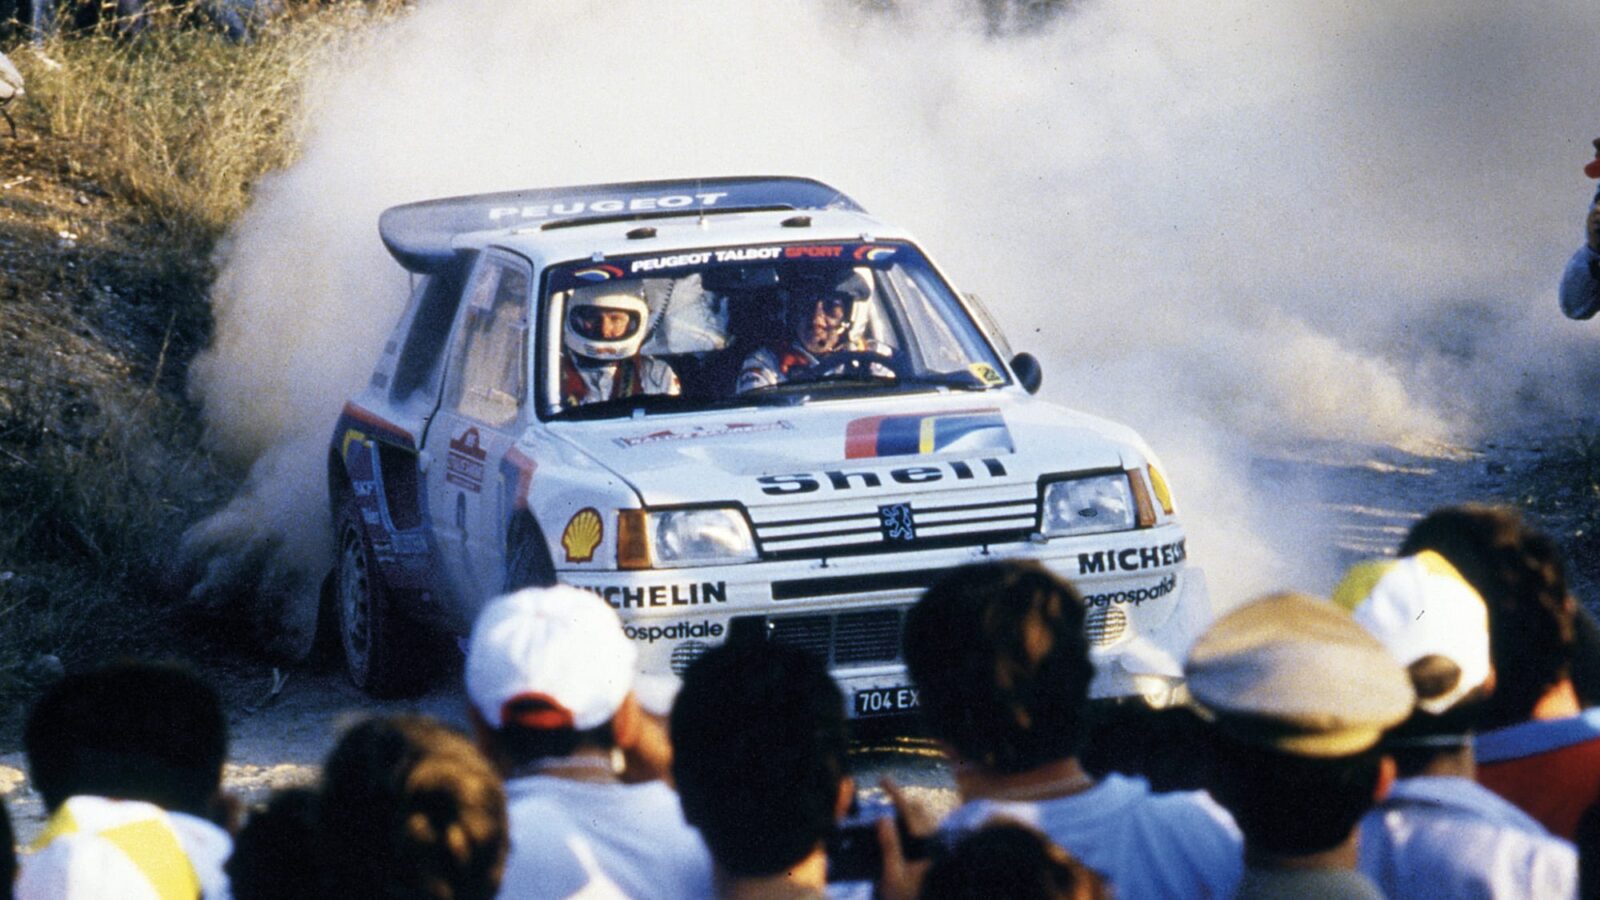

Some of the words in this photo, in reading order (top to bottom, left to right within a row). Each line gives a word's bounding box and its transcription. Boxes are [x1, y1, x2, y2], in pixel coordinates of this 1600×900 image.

[488, 192, 728, 220] PEUGEOT
[631, 252, 712, 273] PEUGEOT
[714, 247, 782, 262] TALBOT
[783, 246, 844, 259] SPORT
[756, 458, 1008, 495] Shell
[574, 580, 727, 610] CHELIN
[621, 620, 724, 643] ospatiale
[859, 691, 892, 712] 704
